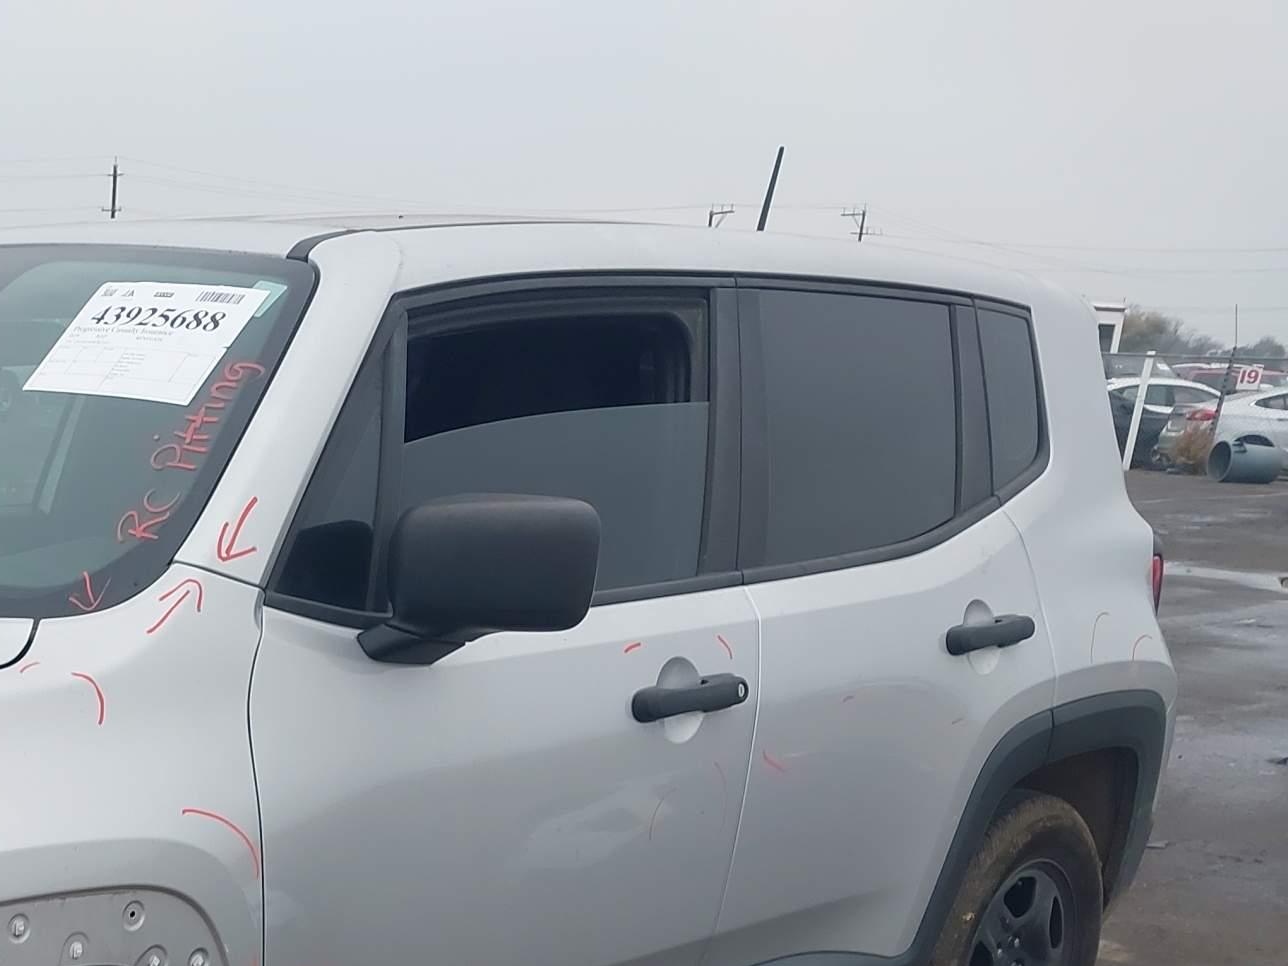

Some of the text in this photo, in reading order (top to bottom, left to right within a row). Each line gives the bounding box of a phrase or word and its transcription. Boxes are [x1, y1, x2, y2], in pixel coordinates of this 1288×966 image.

[91, 305, 227, 333] 43925688
[1239, 369, 1260, 385] 19
[116, 489, 181, 544] RC
